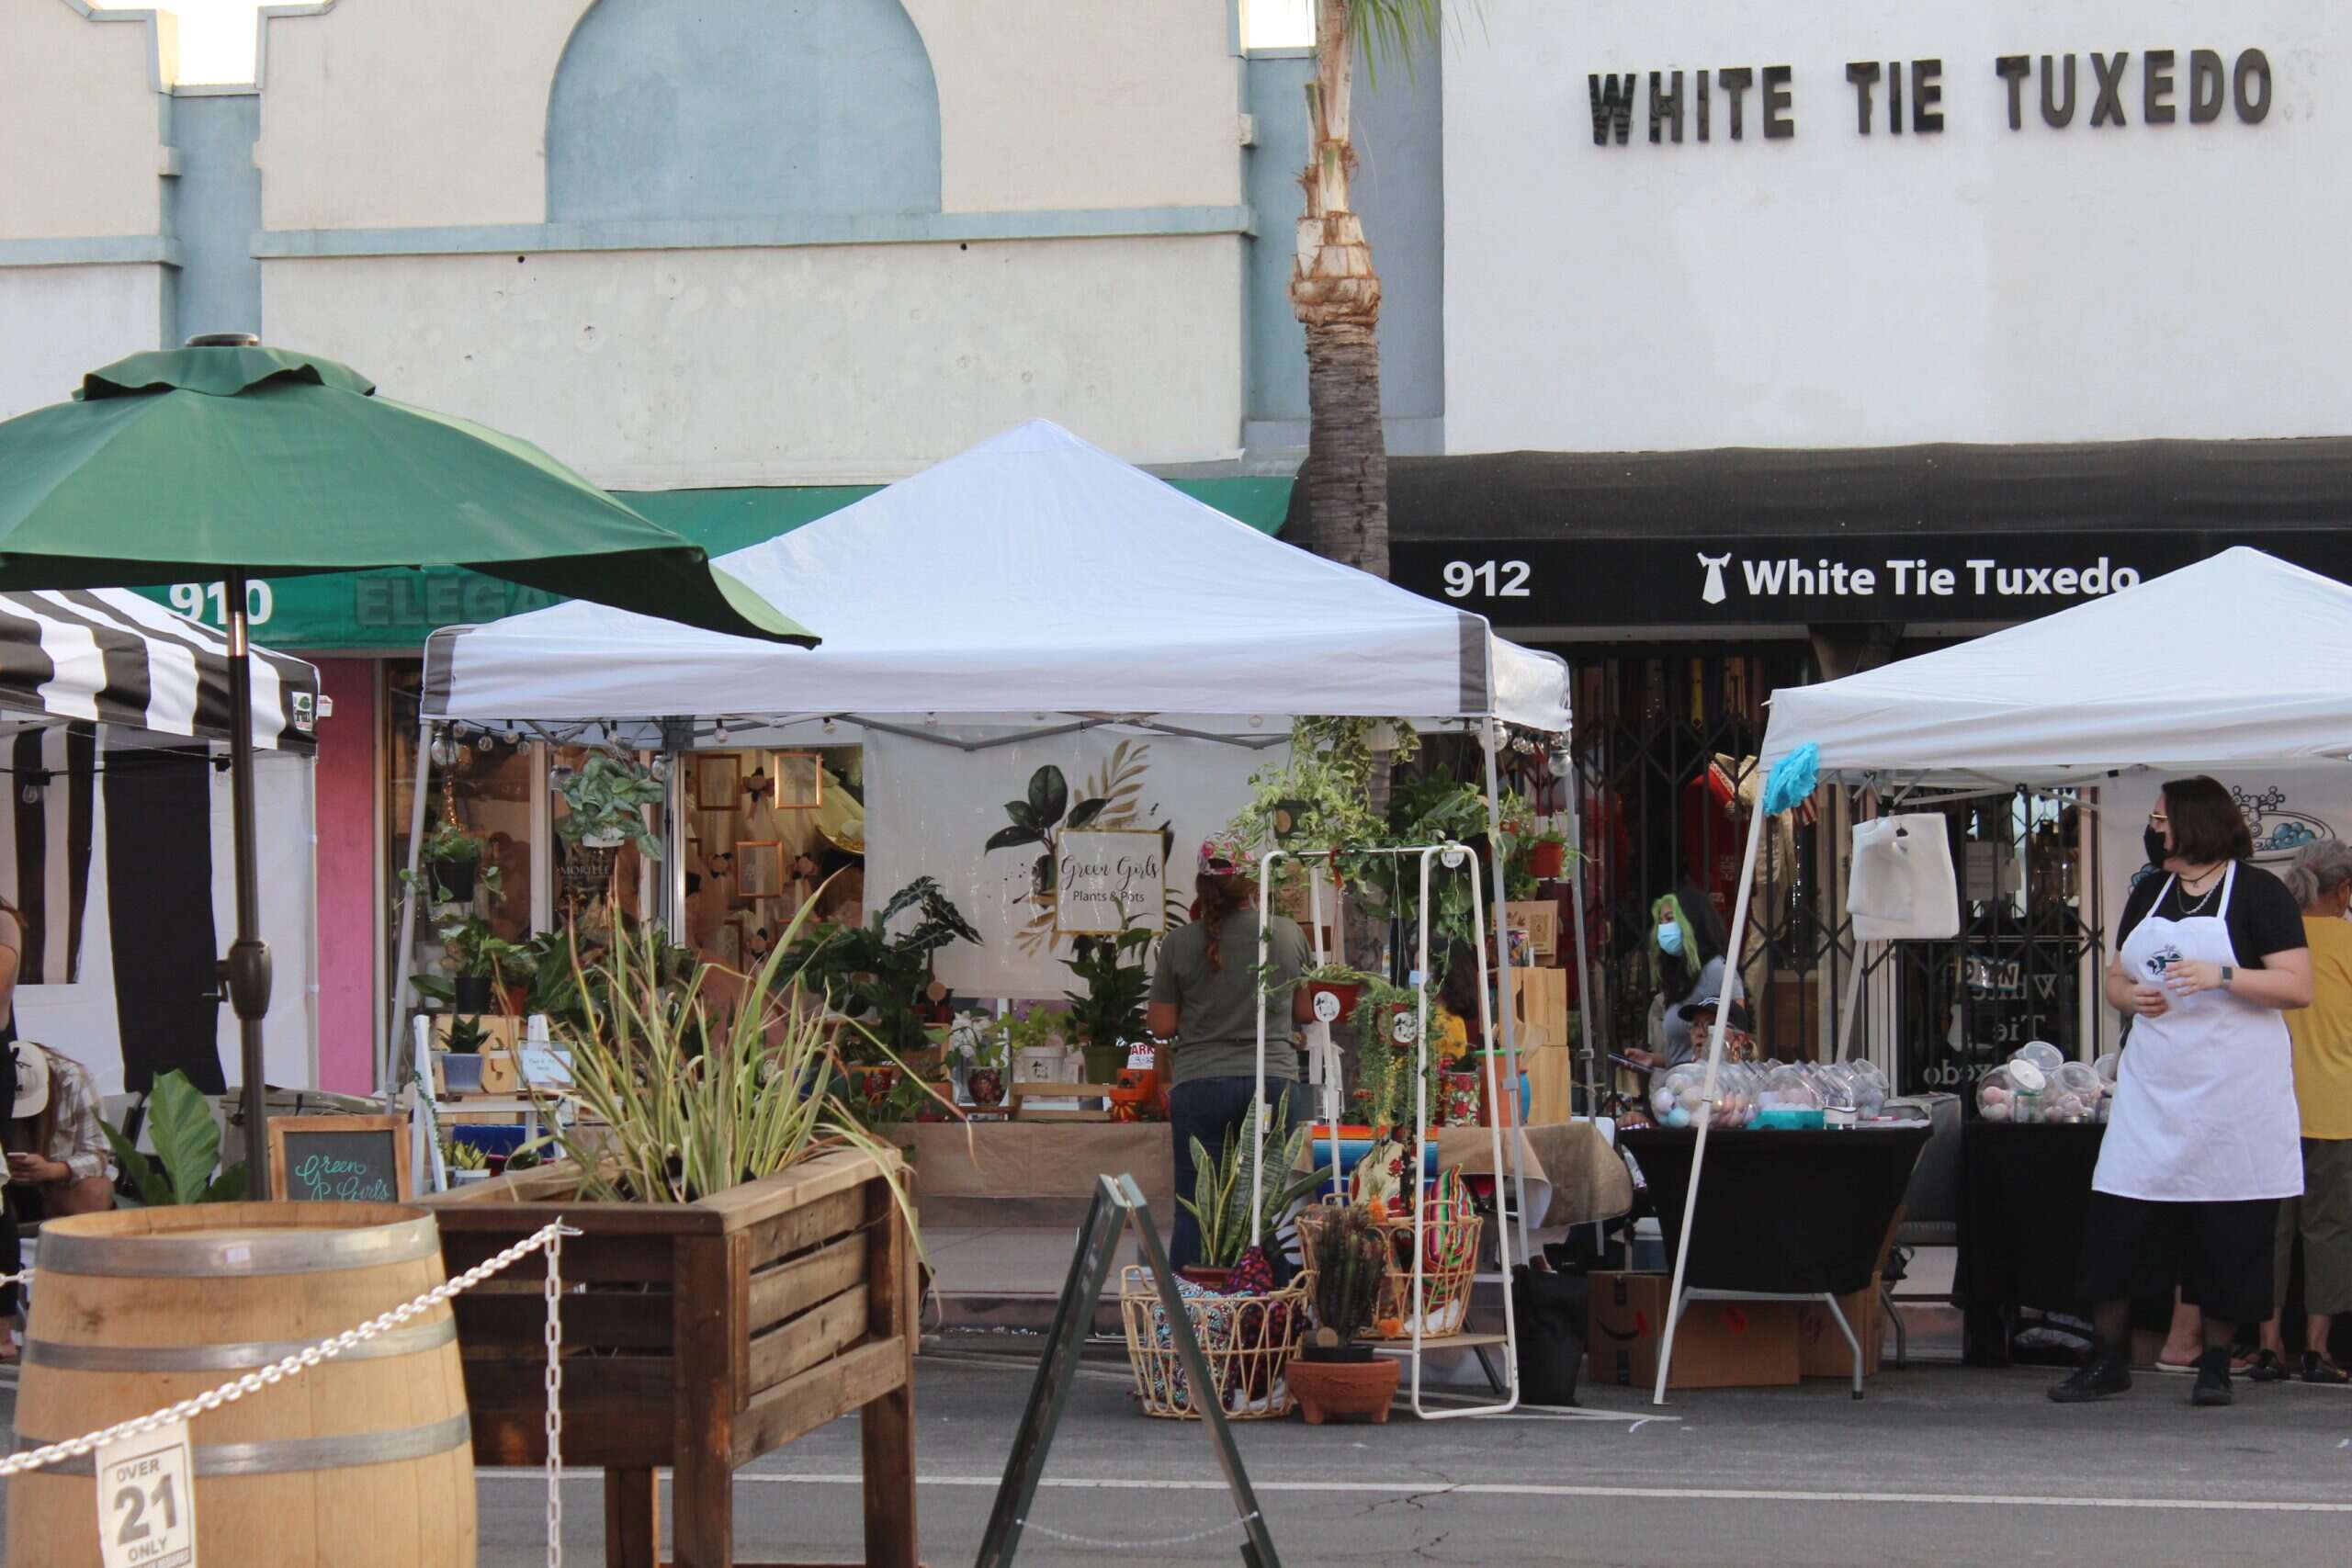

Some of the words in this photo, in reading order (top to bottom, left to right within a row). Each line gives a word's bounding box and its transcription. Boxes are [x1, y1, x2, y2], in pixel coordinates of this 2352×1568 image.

[1588, 64, 1794, 147] WHITE
[1846, 59, 1945, 135] TIE
[1996, 48, 2273, 131] TUXEDO
[1442, 559, 1531, 598] 912
[1742, 558, 1875, 596] White
[1886, 558, 1956, 596] Tie
[1966, 557, 2140, 596] Tuxedo
[169, 579, 273, 626] 910
[356, 576, 571, 626] ELEGA
[1060, 854, 1110, 890] Green
[1115, 853, 1159, 891] Girls
[1073, 890, 1107, 902] Plants
[1121, 891, 1145, 903] Pots
[295, 1155, 368, 1201] Green
[117, 1458, 160, 1483] OVER
[114, 1473, 177, 1547] 21
[128, 1536, 167, 1562] ONLY
